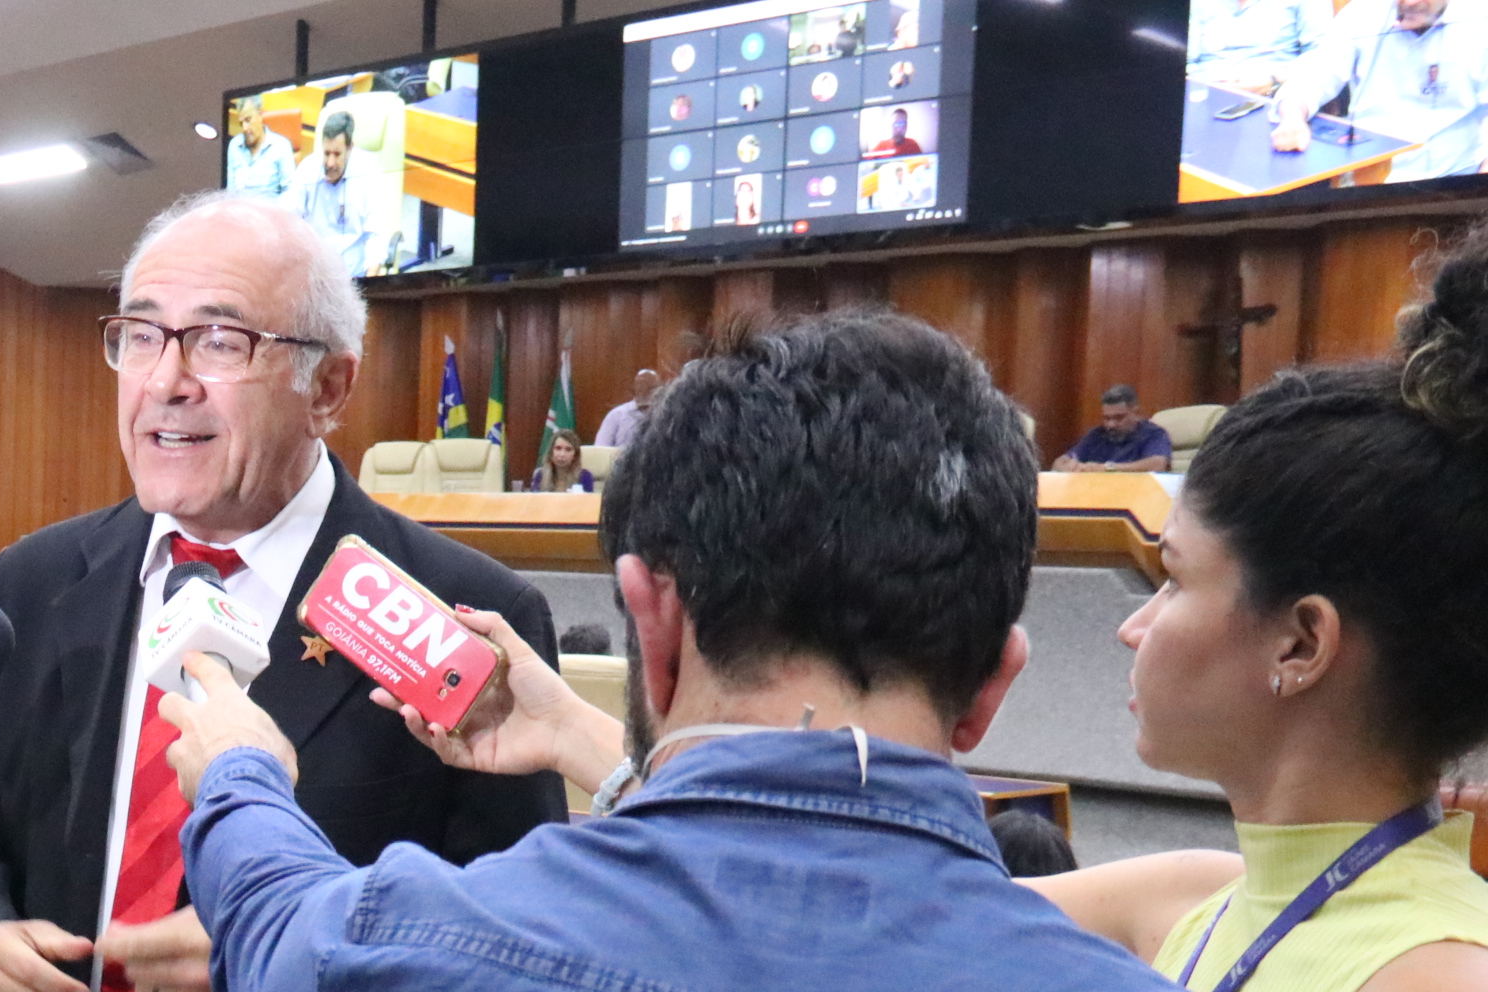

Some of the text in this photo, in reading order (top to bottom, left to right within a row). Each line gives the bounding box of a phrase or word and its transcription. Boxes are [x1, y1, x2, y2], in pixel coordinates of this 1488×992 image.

[341, 562, 469, 668] CBN
[310, 641, 325, 652] PT
[324, 595, 427, 678] A RÁDIO QUE TOCA NOTÍCIA
[325, 621, 368, 659] GOIÂNIA
[1325, 861, 1350, 892] JC
